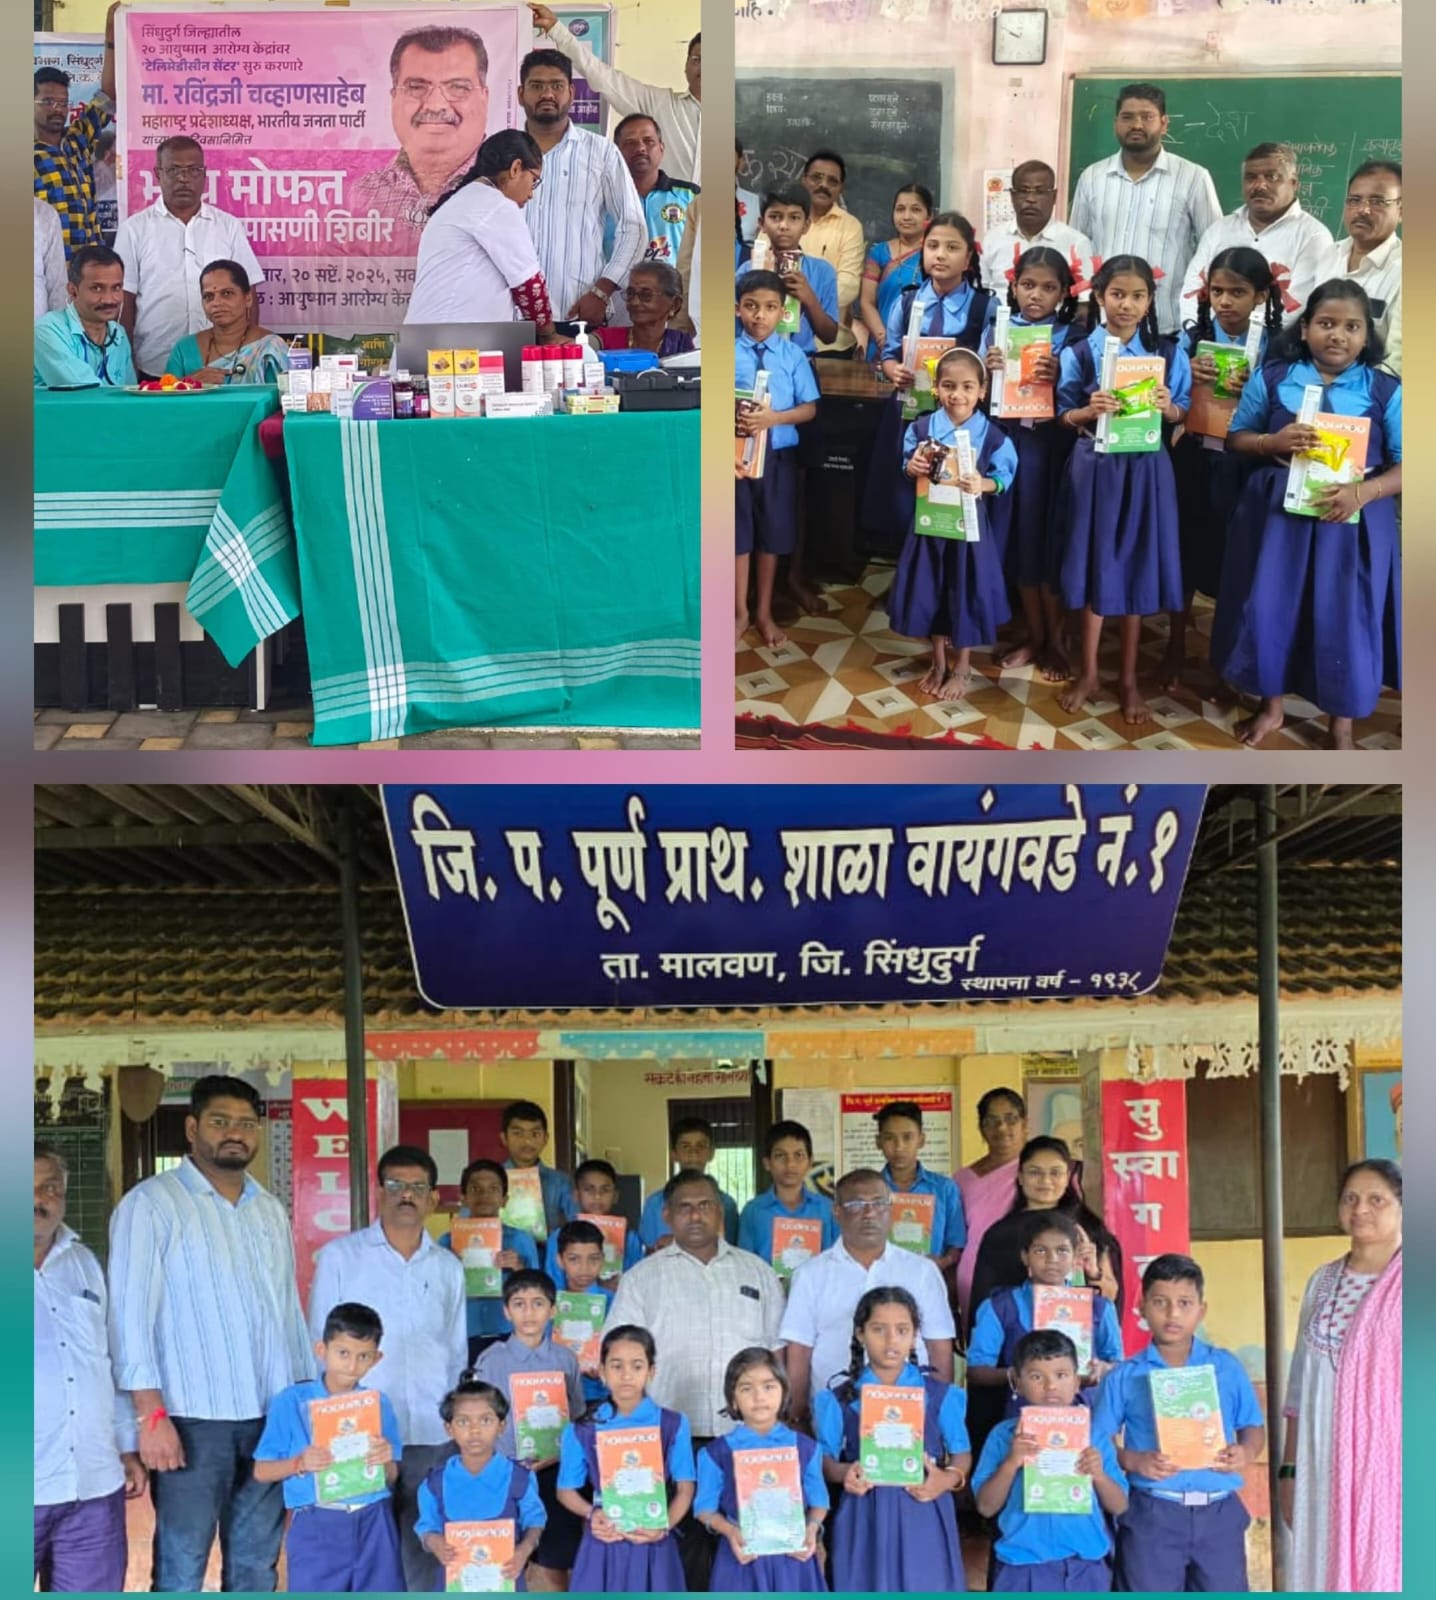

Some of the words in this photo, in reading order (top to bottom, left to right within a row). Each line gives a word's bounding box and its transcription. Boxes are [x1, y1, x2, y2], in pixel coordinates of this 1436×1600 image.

[141, 23, 181, 41] सिंधुदुर्ग
[141, 45, 156, 55] २०
[159, 44, 207, 58] आयुष्मान
[212, 41, 250, 55] आरोग्य
[252, 42, 291, 56] केंद्रांवर
[264, 58, 304, 72] करणारे
[141, 83, 168, 105] मा.
[174, 77, 242, 107] रविंद्रजी
[247, 76, 366, 107] चव्हाणसाहेब
[142, 114, 187, 132] महाराष्ट्र
[189, 111, 254, 131] प्रदेशाध्यक्ष,
[257, 110, 300, 128] भारतीय
[303, 113, 336, 128] जनता
[339, 109, 366, 128] पार्टी
[228, 156, 347, 206] मोफत
[325, 208, 395, 243] शिबीर
[292, 269, 310, 282] २०
[346, 269, 390, 284] २०२५,
[278, 291, 336, 311] आयुष्मान
[341, 288, 388, 307] आरोग्य
[410, 792, 498, 902] जि.
[503, 830, 564, 903] प.
[571, 795, 648, 933] पूर्ण
[657, 826, 765, 903] प्राथ.
[780, 827, 895, 909] शाळा
[905, 784, 1087, 897] वायंगवडे
[600, 951, 650, 980] ता.
[658, 951, 788, 983] मालवण,
[799, 940, 852, 976] जि.
[863, 934, 985, 985] सिंधुदुर्ग
[960, 974, 1030, 992] स्थापना
[1035, 969, 1066, 990] वर्ष
[1089, 970, 1143, 992] १९३८
